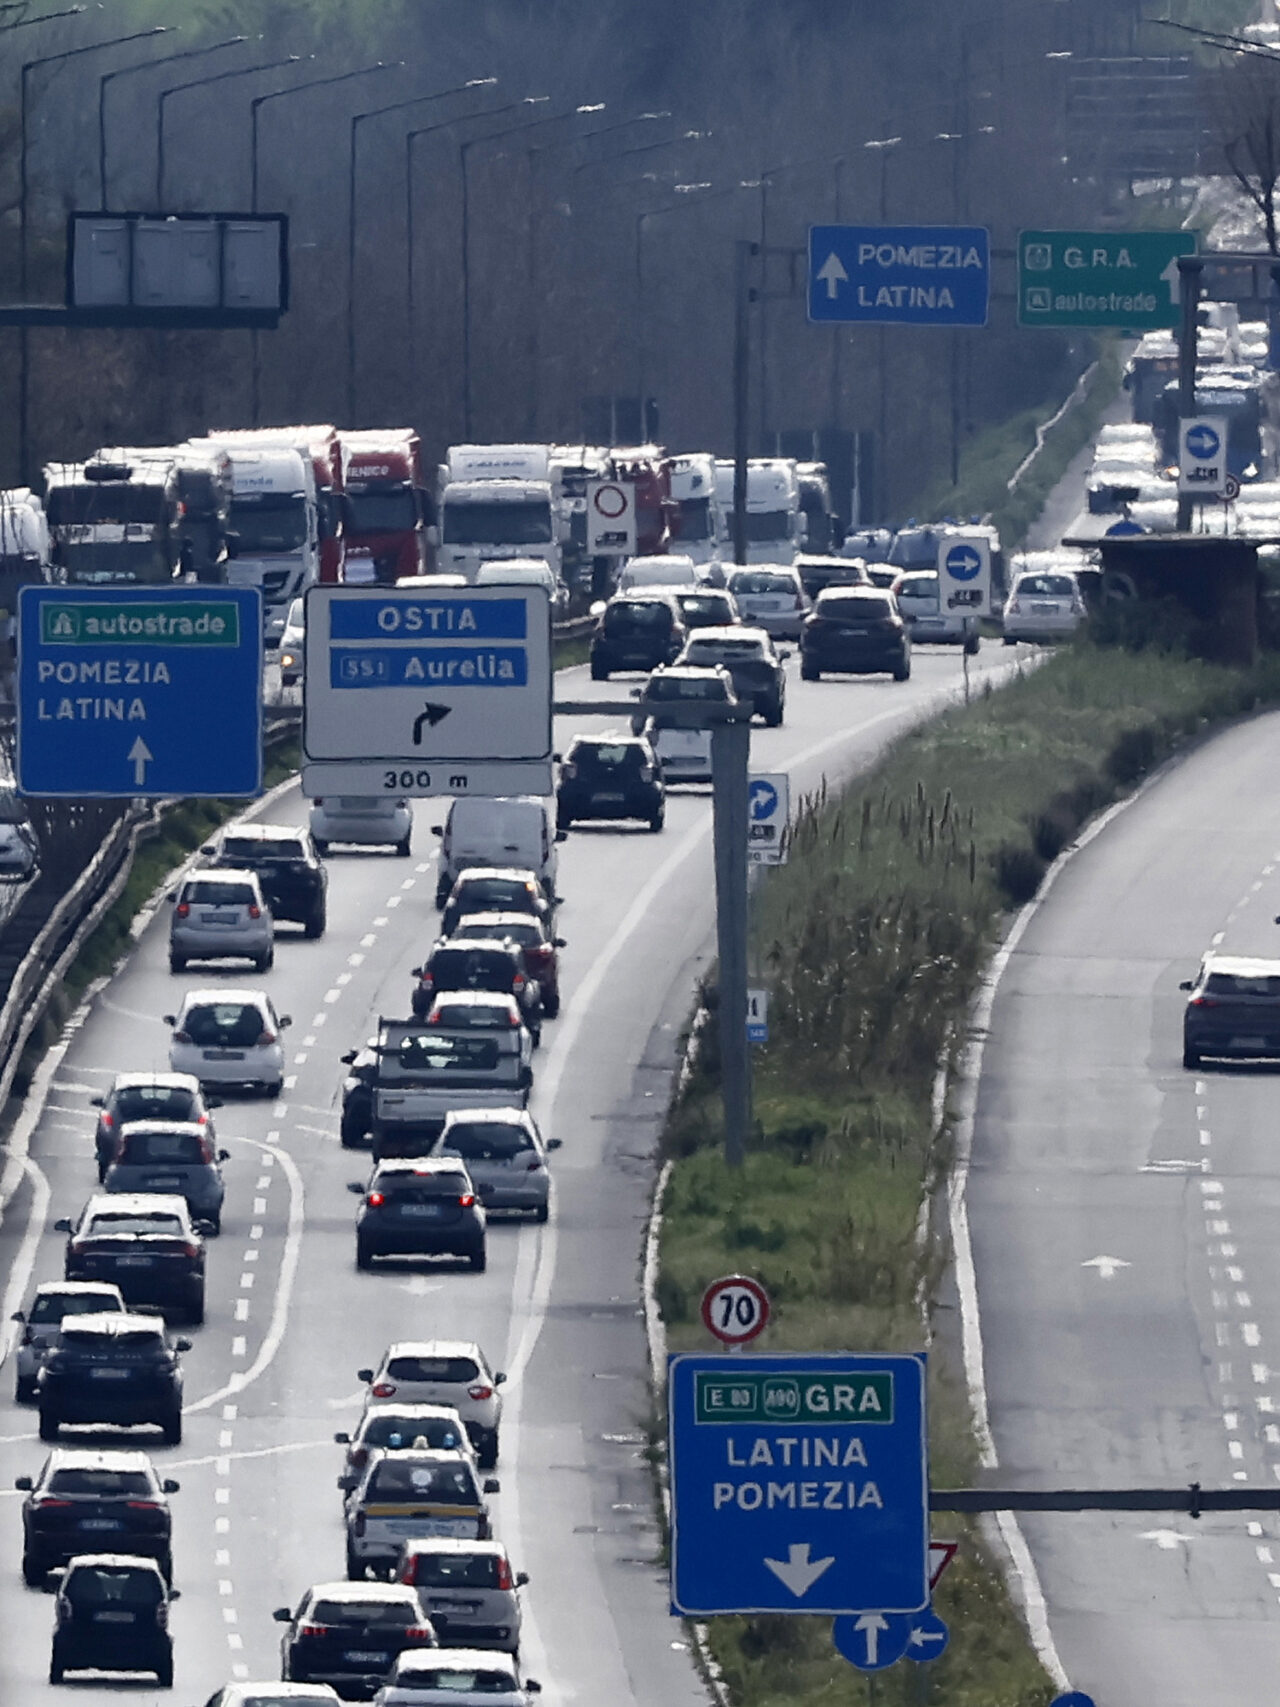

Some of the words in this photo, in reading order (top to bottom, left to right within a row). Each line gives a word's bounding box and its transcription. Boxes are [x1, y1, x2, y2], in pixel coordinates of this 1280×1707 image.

[858, 244, 982, 269] POMEZIA
[857, 286, 955, 309] LATINA
[1055, 292, 1157, 312] autostrade
[86, 612, 226, 635] autostrade
[377, 606, 477, 631] OSTIA
[38, 661, 170, 684] POMEZIA
[405, 655, 515, 679] Aurelia
[38, 698, 147, 720] LATINA
[384, 770, 431, 788] 300
[449, 775, 468, 788] m
[720, 1295, 755, 1328] 70
[711, 1389, 724, 1407] E
[805, 1384, 882, 1413] GRA
[726, 1437, 868, 1467] LATINA
[713, 1481, 883, 1510] POMEZIA
